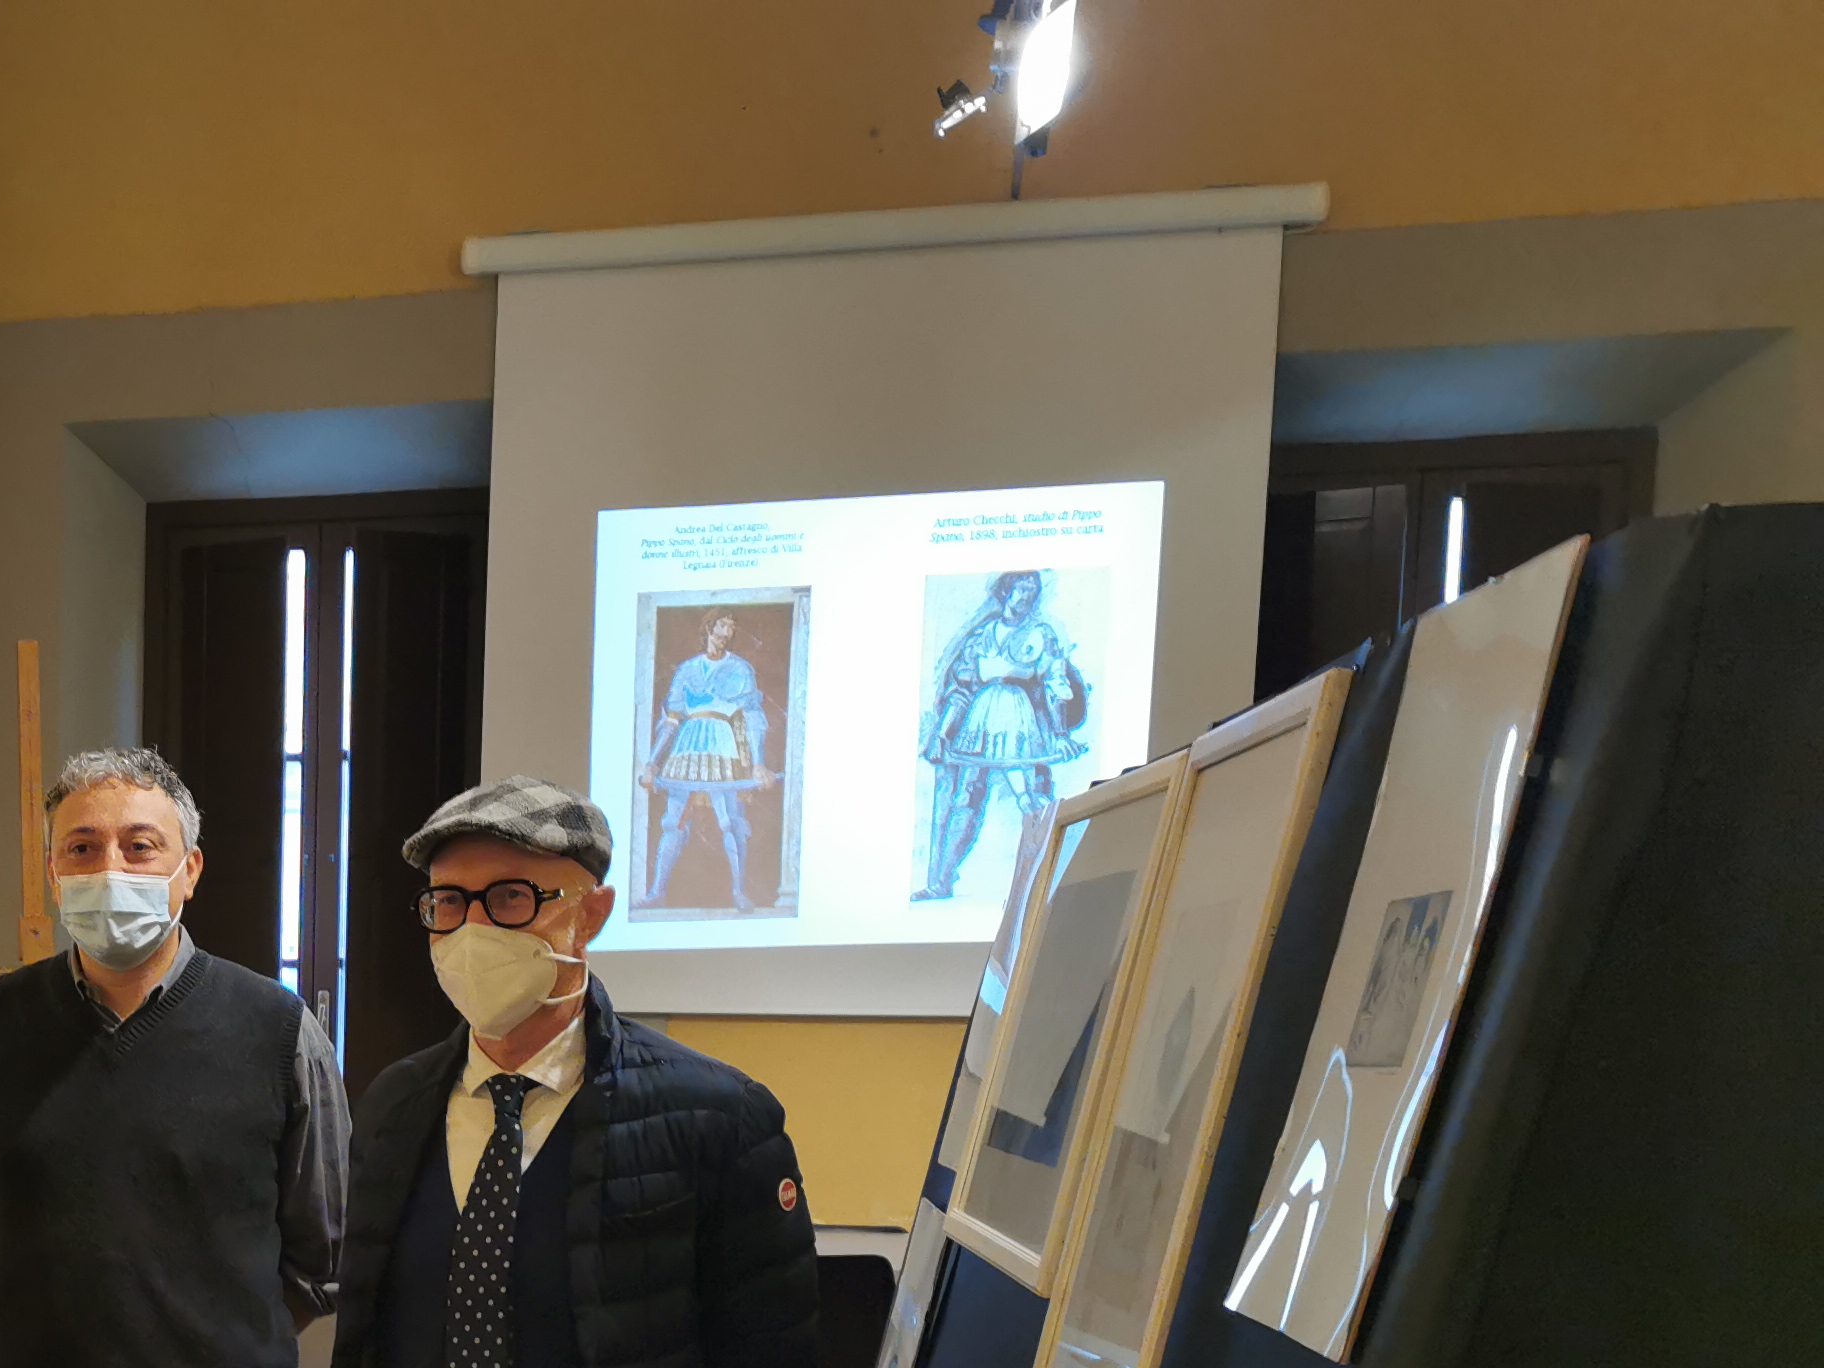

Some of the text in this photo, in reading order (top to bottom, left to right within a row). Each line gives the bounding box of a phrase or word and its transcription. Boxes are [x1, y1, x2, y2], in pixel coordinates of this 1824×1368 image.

[934, 518, 970, 527] Arturo
[973, 513, 1018, 525] Checchi,
[1023, 511, 1055, 522] studio
[1072, 509, 1102, 522] Pippo
[675, 525, 706, 534] Andrea
[709, 524, 723, 532] Del
[970, 529, 998, 540] 1898,
[1002, 526, 1057, 539] inchiostro
[1077, 524, 1104, 534] carta
[700, 536, 712, 544] dal
[741, 533, 762, 543] degli
[732, 546, 767, 556] affresco
[782, 544, 802, 553] Villa
[719, 559, 758, 568] (Firenze)
